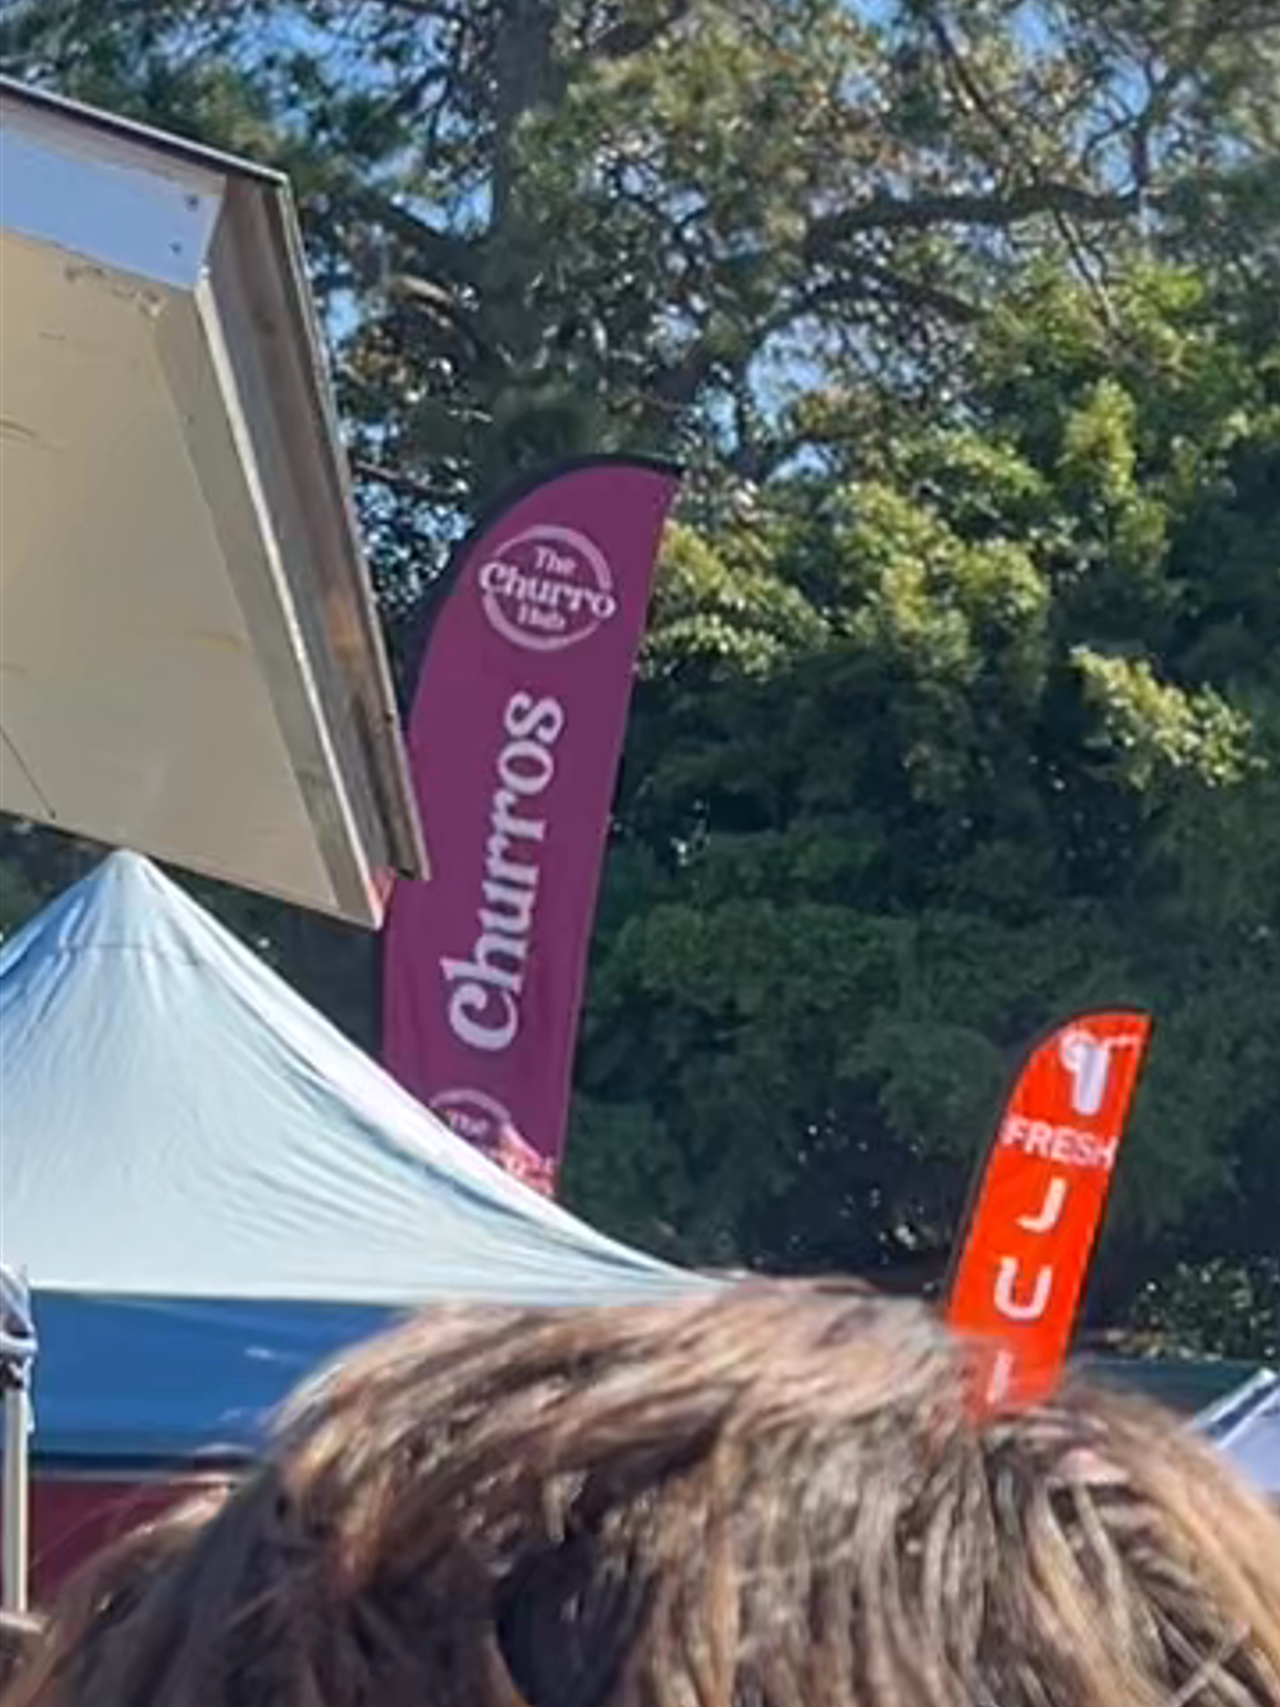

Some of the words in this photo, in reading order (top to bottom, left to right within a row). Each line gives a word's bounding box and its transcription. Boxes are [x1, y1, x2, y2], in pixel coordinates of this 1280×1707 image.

[534, 546, 577, 575] The
[478, 562, 616, 618] Churro
[439, 691, 565, 1051] Churros
[1001, 1115, 1120, 1170] FRESH
